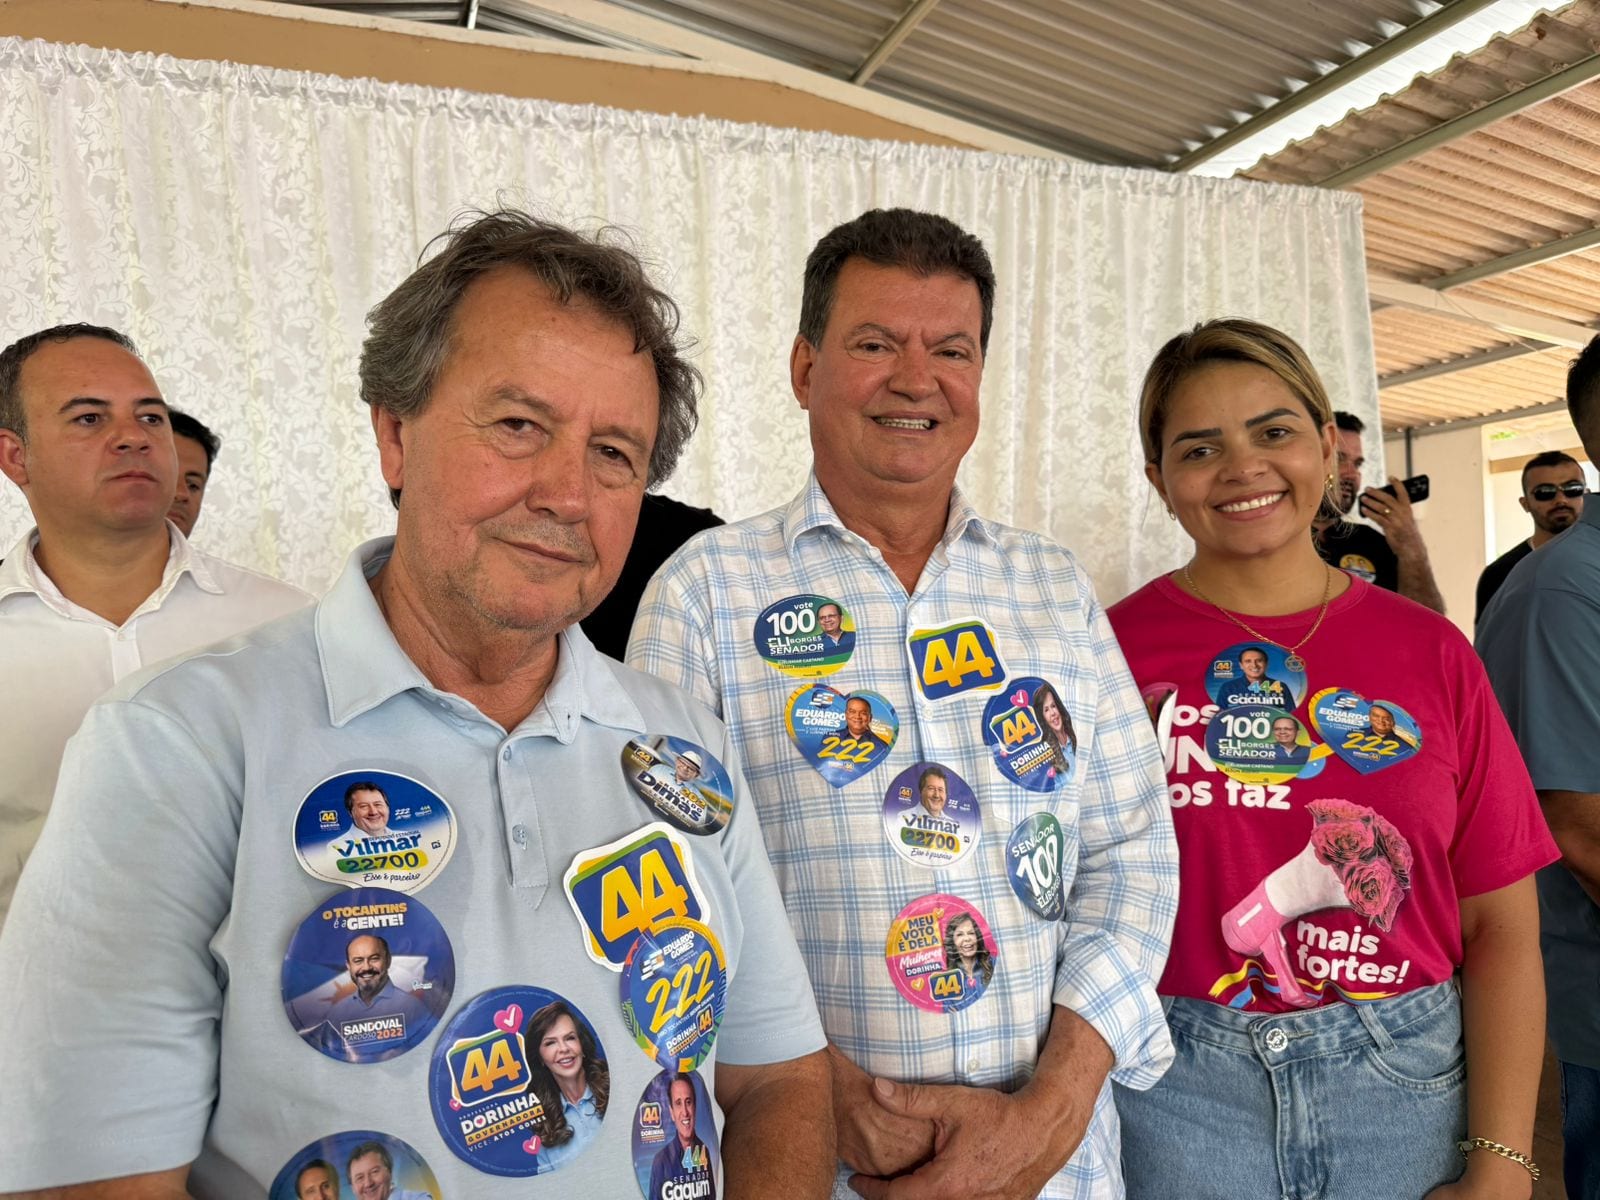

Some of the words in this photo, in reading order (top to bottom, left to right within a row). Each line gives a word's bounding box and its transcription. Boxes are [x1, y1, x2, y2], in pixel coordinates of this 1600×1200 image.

[794, 601, 814, 610] vote
[766, 608, 816, 636] 100
[768, 636, 790, 649] ELI
[790, 635, 822, 644] BORGES
[770, 643, 824, 655] SENADOR
[923, 631, 995, 687] 44
[1247, 680, 1284, 693] 444
[796, 708, 846, 721] EDUARDO
[802, 717, 841, 728] GOMES
[1319, 707, 1370, 722] EDUARDO
[1326, 715, 1365, 727] GOMES
[1002, 711, 1036, 745] 44
[1220, 714, 1271, 739] 100
[817, 737, 875, 763] 222
[1218, 738, 1241, 749] ELI
[1241, 742, 1275, 750] BORGES
[1219, 748, 1276, 758] SENADOR
[1341, 733, 1400, 756] 222
[1010, 741, 1051, 770] DORINHA
[637, 770, 702, 822] Dimas
[321, 812, 336, 822] 44
[903, 814, 960, 834] Vilmar
[333, 834, 421, 857] Vilmar
[906, 830, 955, 851] 22700
[346, 852, 419, 873] 22700
[1016, 834, 1058, 898] 100
[601, 848, 689, 943] 44
[322, 910, 333, 920] O
[333, 902, 407, 918] TOCANTINS
[341, 919, 347, 928] a
[347, 913, 404, 930] GENTE!
[908, 915, 934, 929] MEU
[663, 931, 695, 955] EDUARDO
[898, 938, 906, 952] É
[909, 936, 939, 950] DELA
[901, 926, 934, 942] VOTO
[1297, 920, 1380, 955] mais
[900, 949, 943, 970] Mulheres
[906, 963, 941, 976] DORINHA
[1297, 944, 1410, 984] fortes!
[645, 950, 714, 1033] 222
[934, 974, 961, 996] 44
[344, 1018, 403, 1036] SANDOVAL
[700, 1009, 712, 1031] 44
[377, 1027, 403, 1040] 2022
[666, 1022, 697, 1050] DORINHA
[461, 1039, 522, 1092] 44
[461, 1092, 541, 1135] DORINHA
[643, 1107, 660, 1124] 44
[468, 1107, 542, 1142] GOVERNADORA
[494, 1129, 515, 1142] ATOS
[519, 1115, 547, 1130] GOMES
[681, 1145, 709, 1173] 444
[673, 1171, 710, 1185] SENADOR
